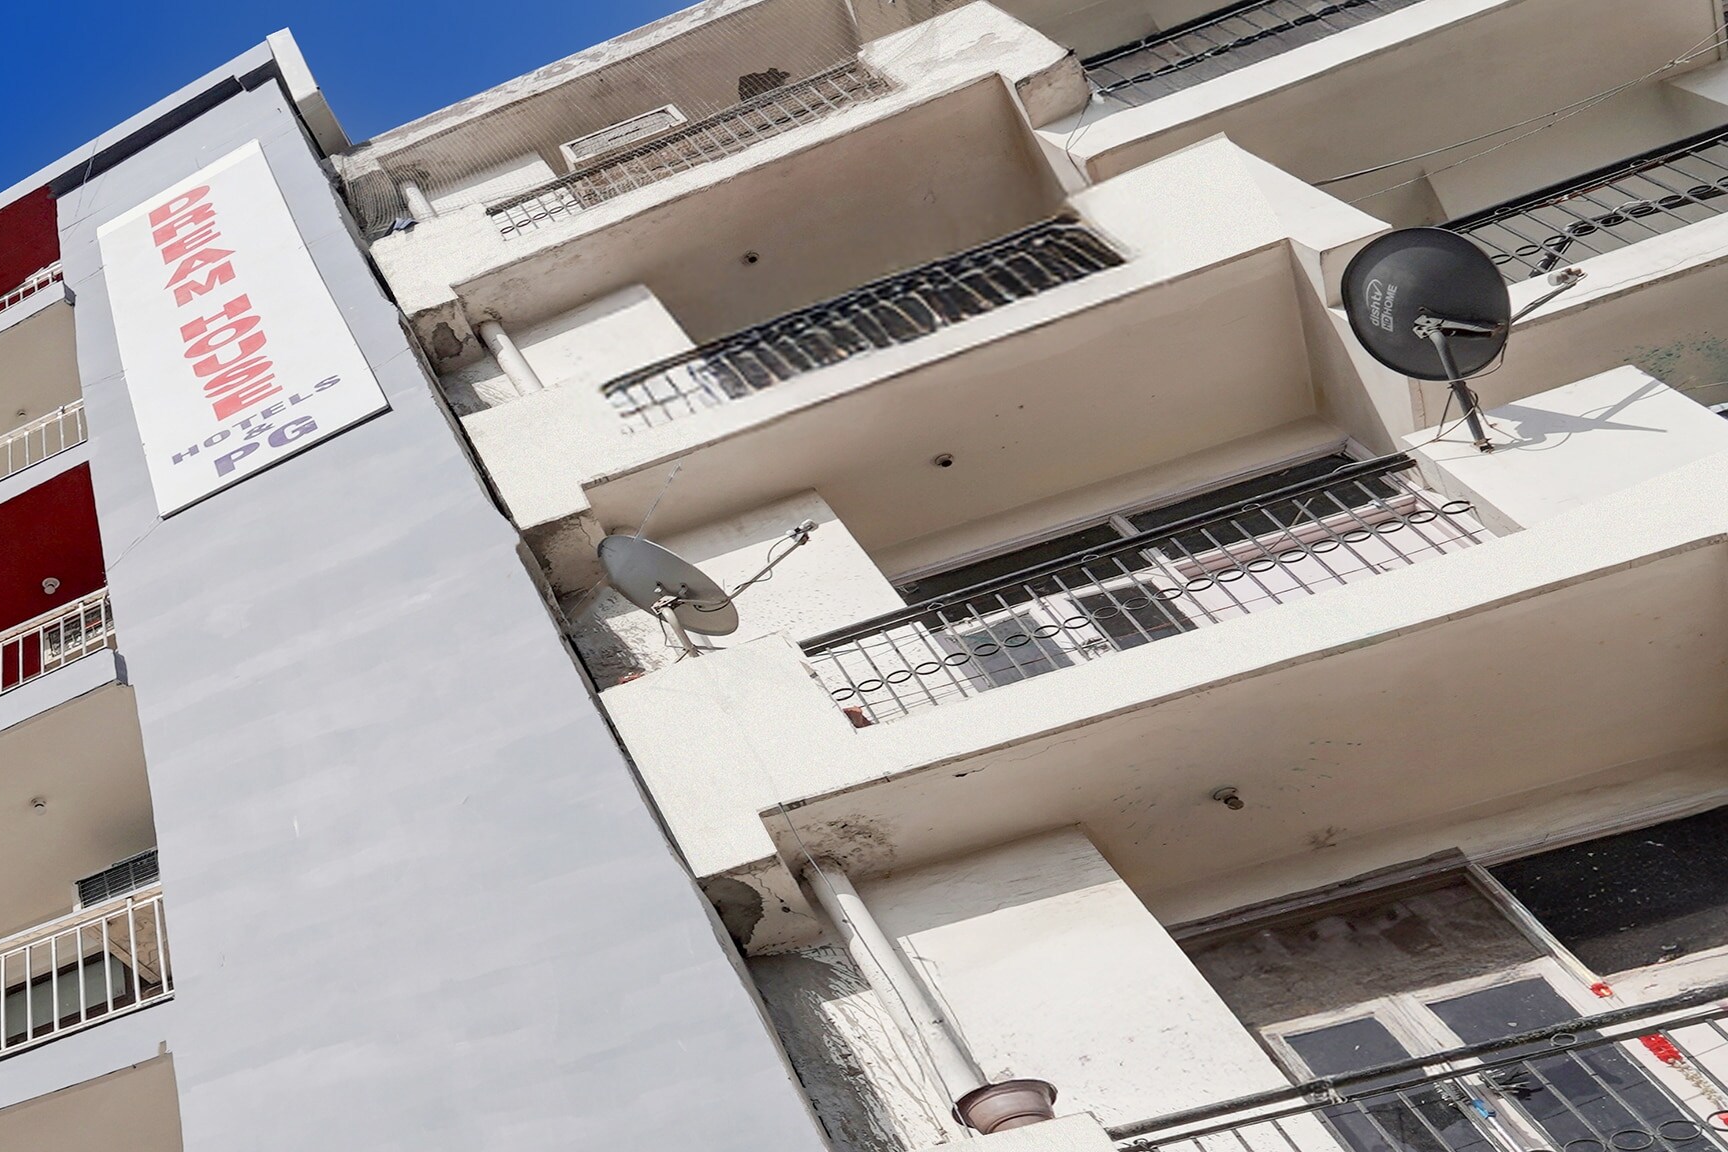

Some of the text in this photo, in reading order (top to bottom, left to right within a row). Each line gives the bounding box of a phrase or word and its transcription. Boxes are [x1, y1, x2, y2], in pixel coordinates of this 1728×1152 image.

[148, 185, 283, 421] DREAM HOUSE
[1382, 284, 1398, 315] HOME
[172, 375, 342, 465] HOTELS
[213, 415, 318, 477] PG
[244, 424, 276, 441] &
